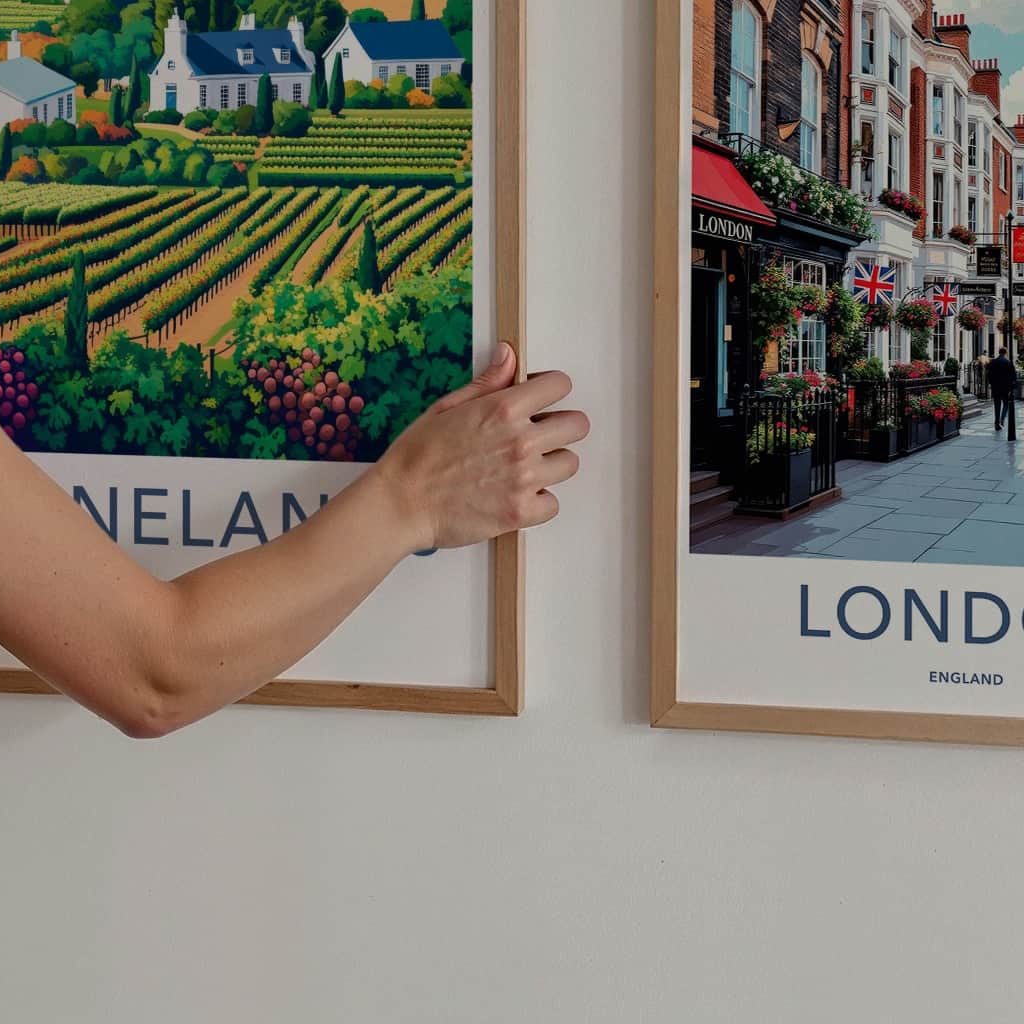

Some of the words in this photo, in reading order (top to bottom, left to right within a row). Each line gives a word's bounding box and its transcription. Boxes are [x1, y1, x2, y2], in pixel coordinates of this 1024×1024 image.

[698, 213, 753, 242] LONDON
[73, 485, 438, 556] NELAN
[799, 583, 1024, 645] LOND
[929, 671, 1004, 686] ENGLAND
